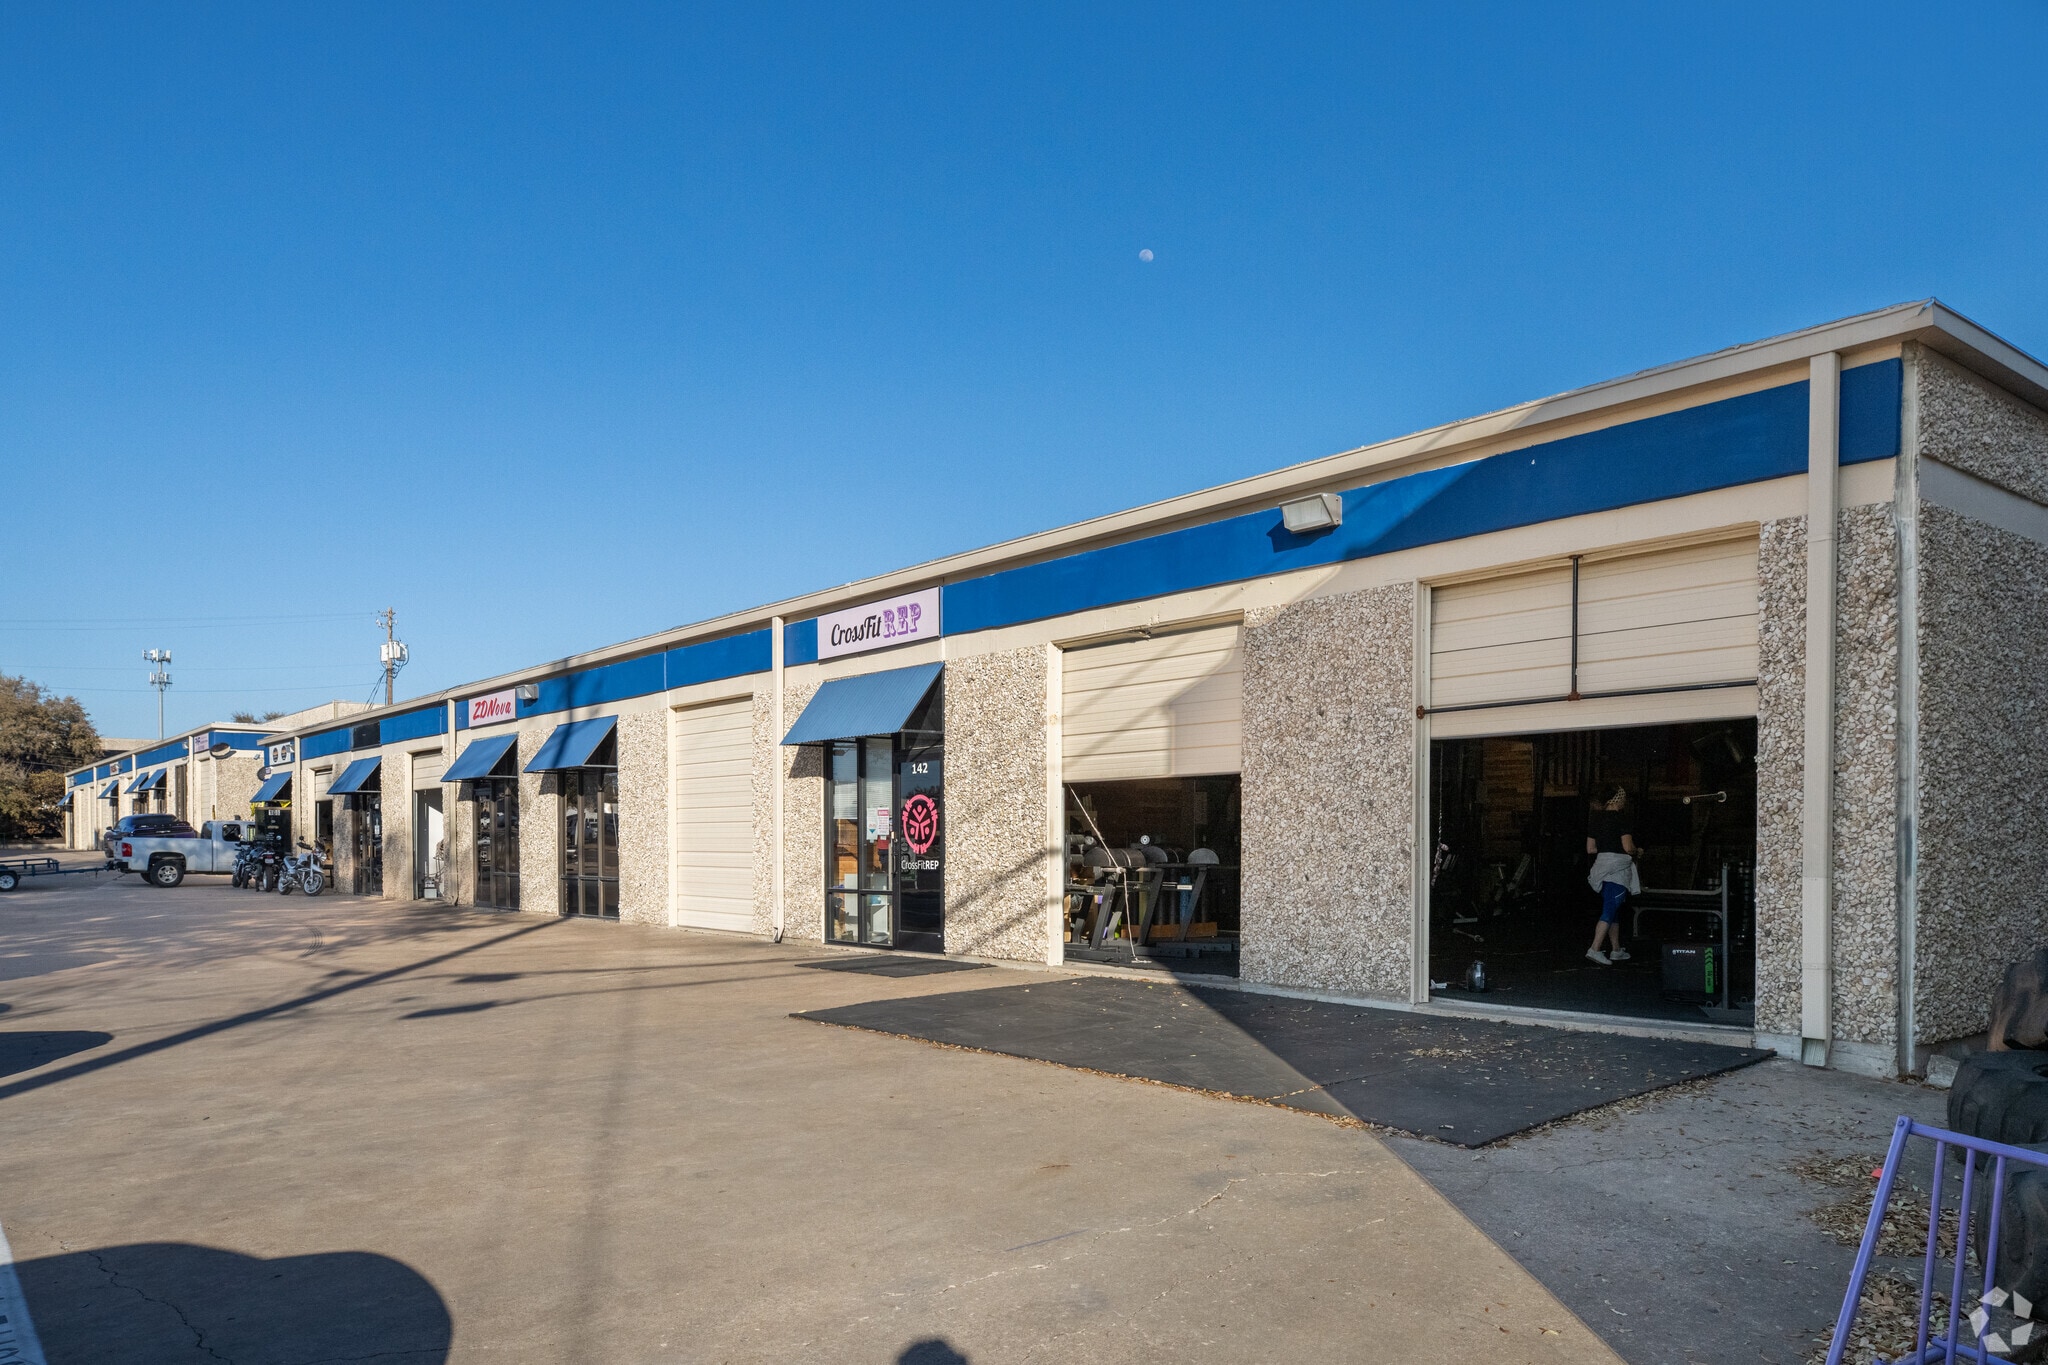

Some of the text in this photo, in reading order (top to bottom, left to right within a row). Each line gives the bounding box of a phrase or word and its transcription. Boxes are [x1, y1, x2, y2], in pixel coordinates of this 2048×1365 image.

[831, 603, 921, 646] CrossFit REP
[912, 763, 928, 774] 142
[901, 860, 939, 870] CrossFitREP
